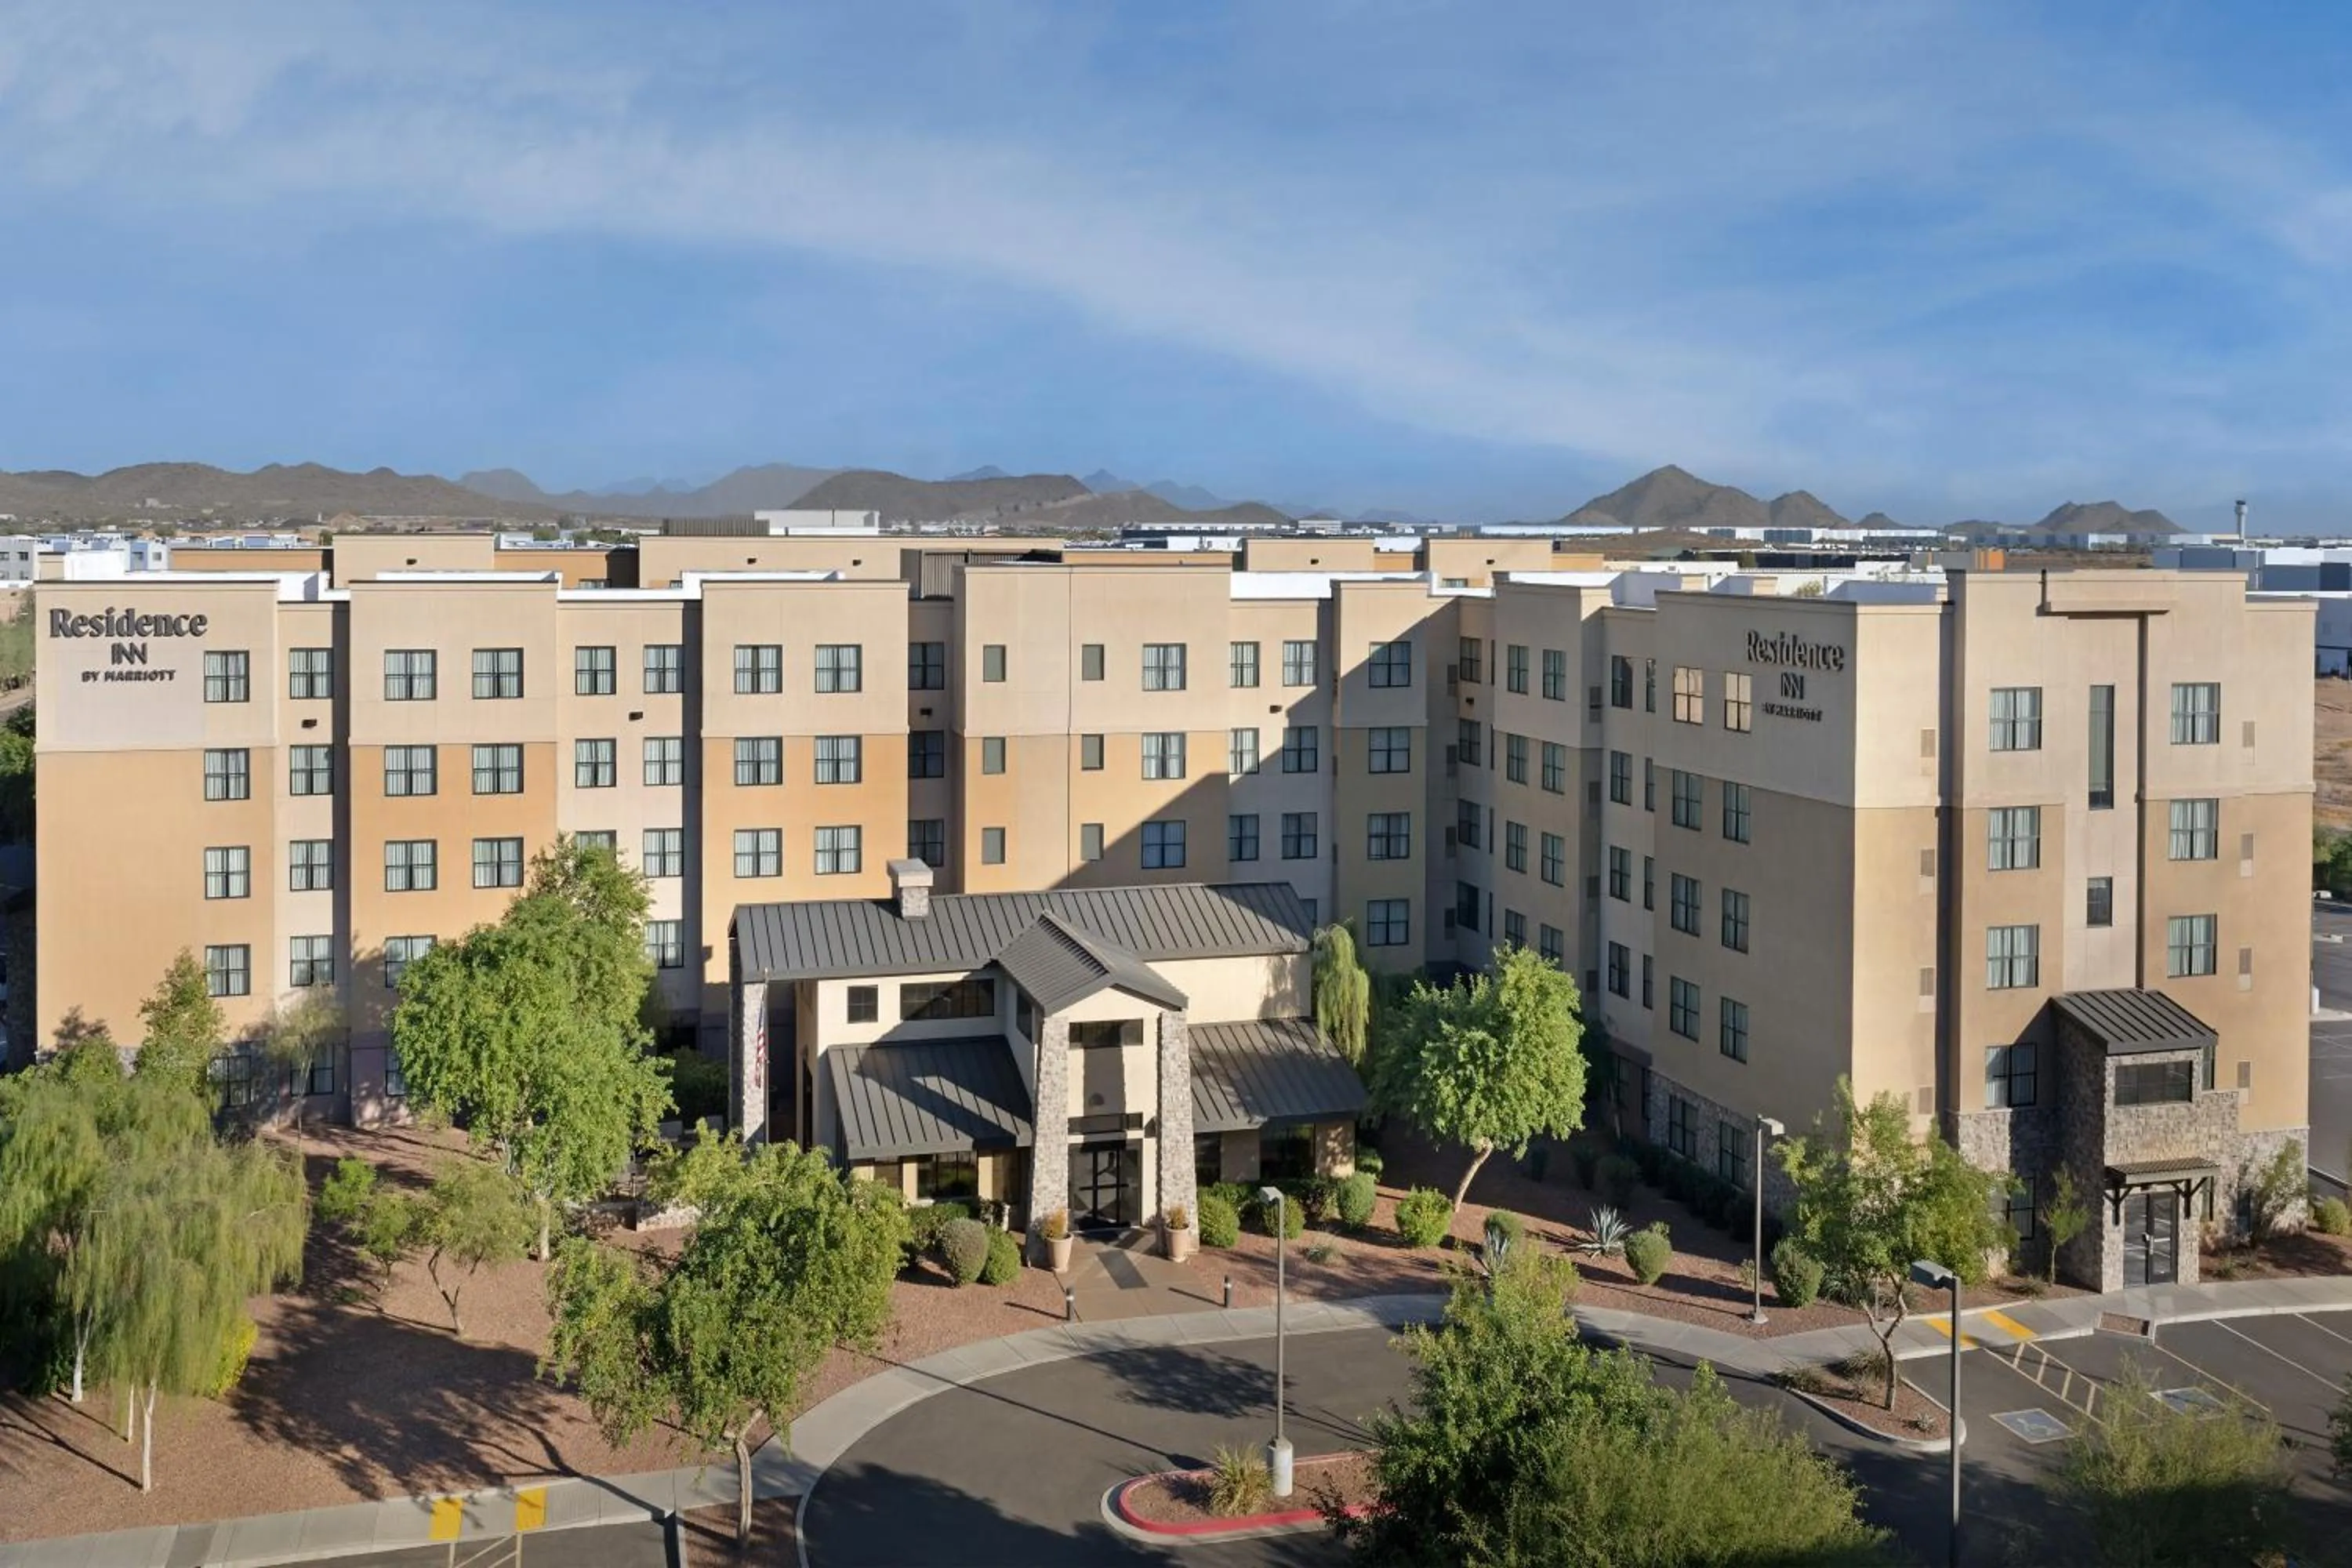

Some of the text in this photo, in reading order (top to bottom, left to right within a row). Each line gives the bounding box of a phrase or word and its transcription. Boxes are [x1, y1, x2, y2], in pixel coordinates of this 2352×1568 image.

[49, 607, 207, 637] Residence
[111, 642, 147, 665] INN
[1746, 630, 1844, 671] Residence
[82, 670, 176, 682] BY MARRIOTT
